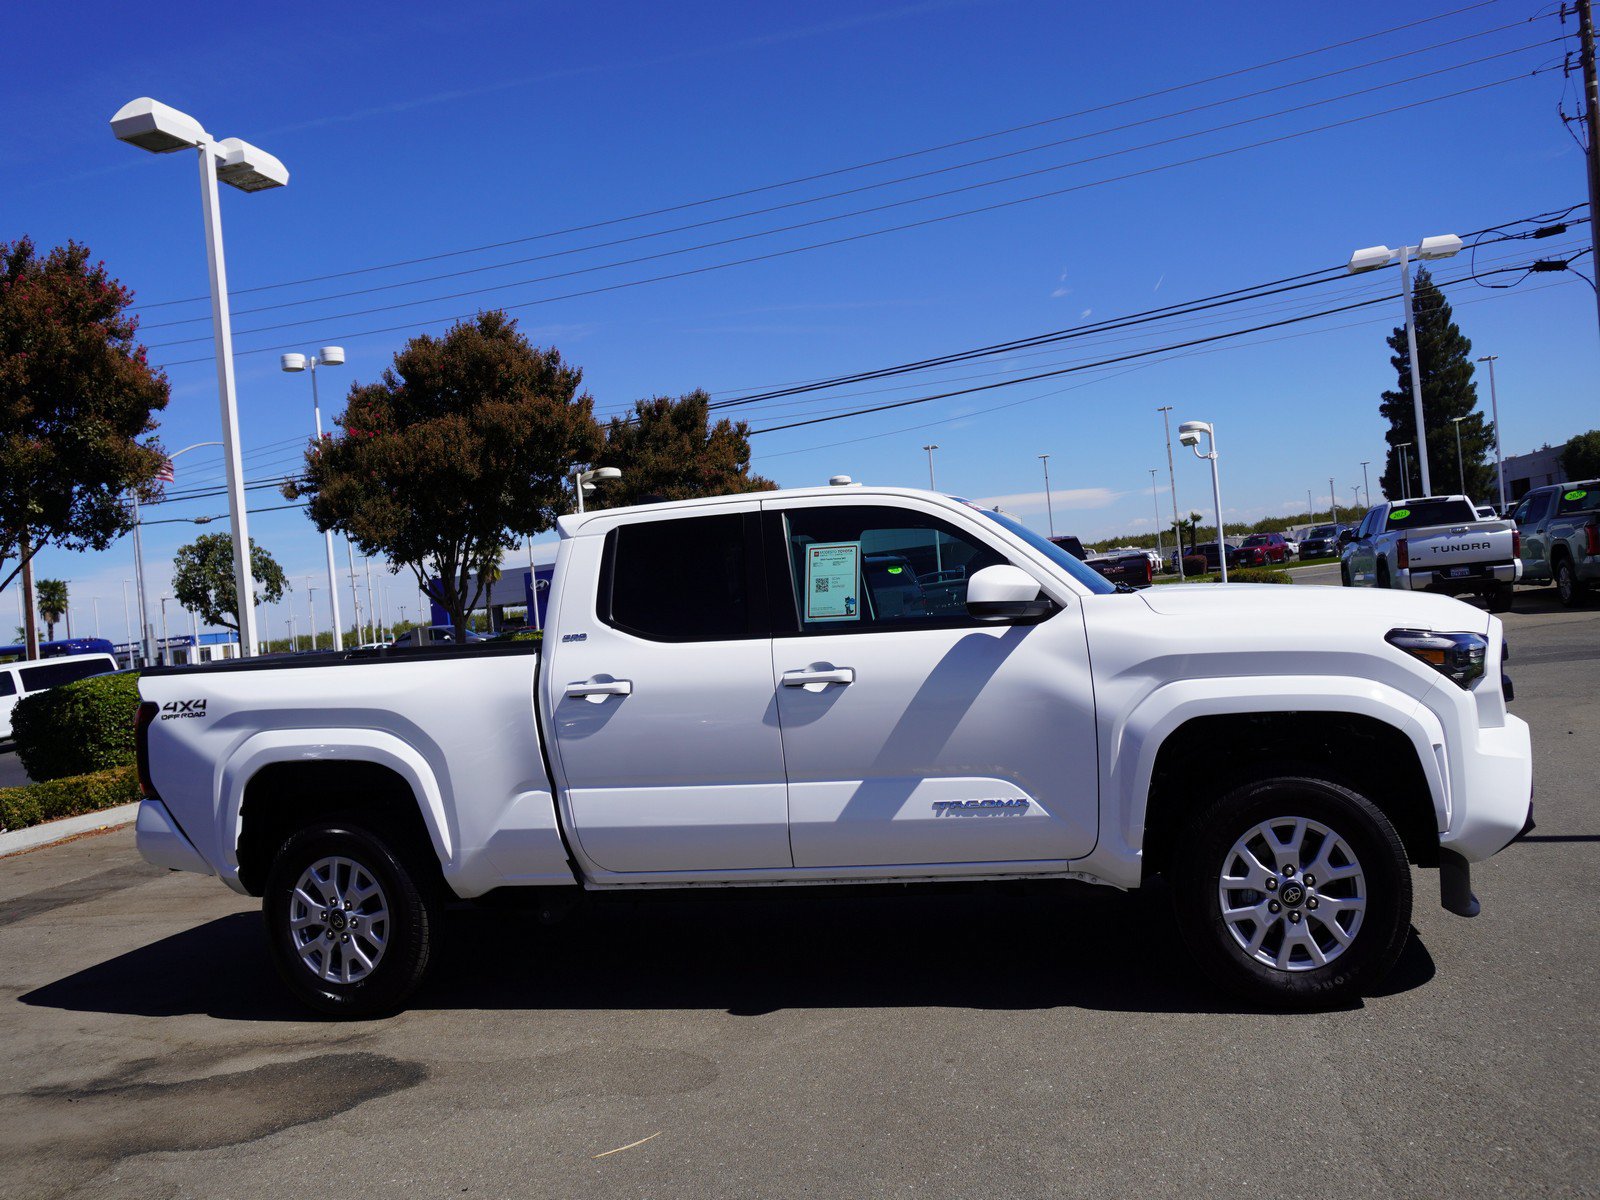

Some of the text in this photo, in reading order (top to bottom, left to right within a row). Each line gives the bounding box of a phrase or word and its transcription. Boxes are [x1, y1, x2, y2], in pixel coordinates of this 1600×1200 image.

[1431, 541, 1491, 554] TUNDRA
[181, 711, 206, 719] ROAD
[931, 799, 1030, 811] TACOMA
